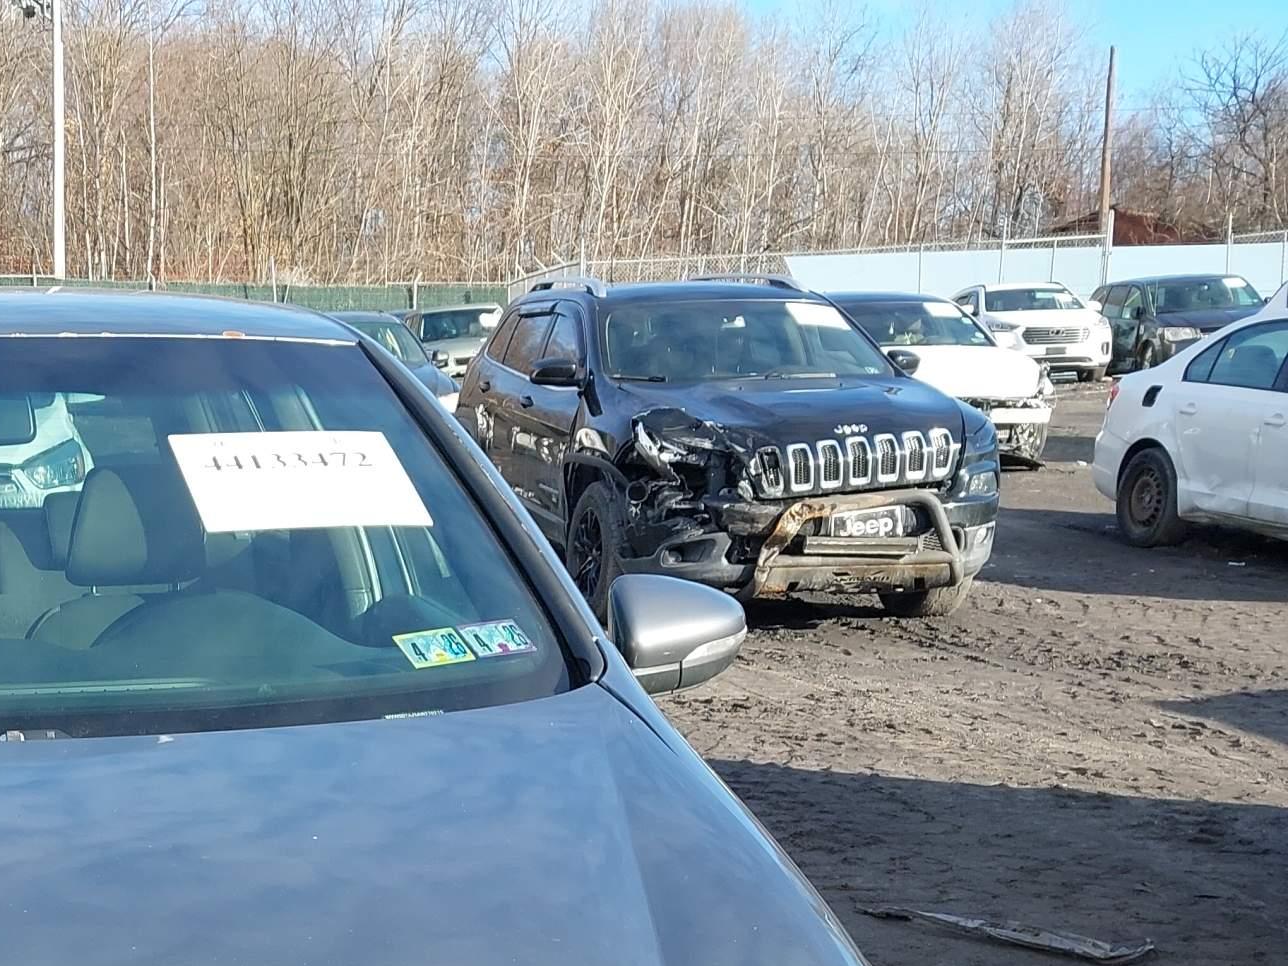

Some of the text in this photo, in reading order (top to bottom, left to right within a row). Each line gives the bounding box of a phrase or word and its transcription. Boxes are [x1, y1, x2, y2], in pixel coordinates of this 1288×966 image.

[834, 424, 868, 434] Jeep
[204, 452, 373, 471] 44133472
[840, 516, 894, 537] Jeep
[411, 632, 467, 662] 4 26
[473, 624, 529, 653] 4 26
